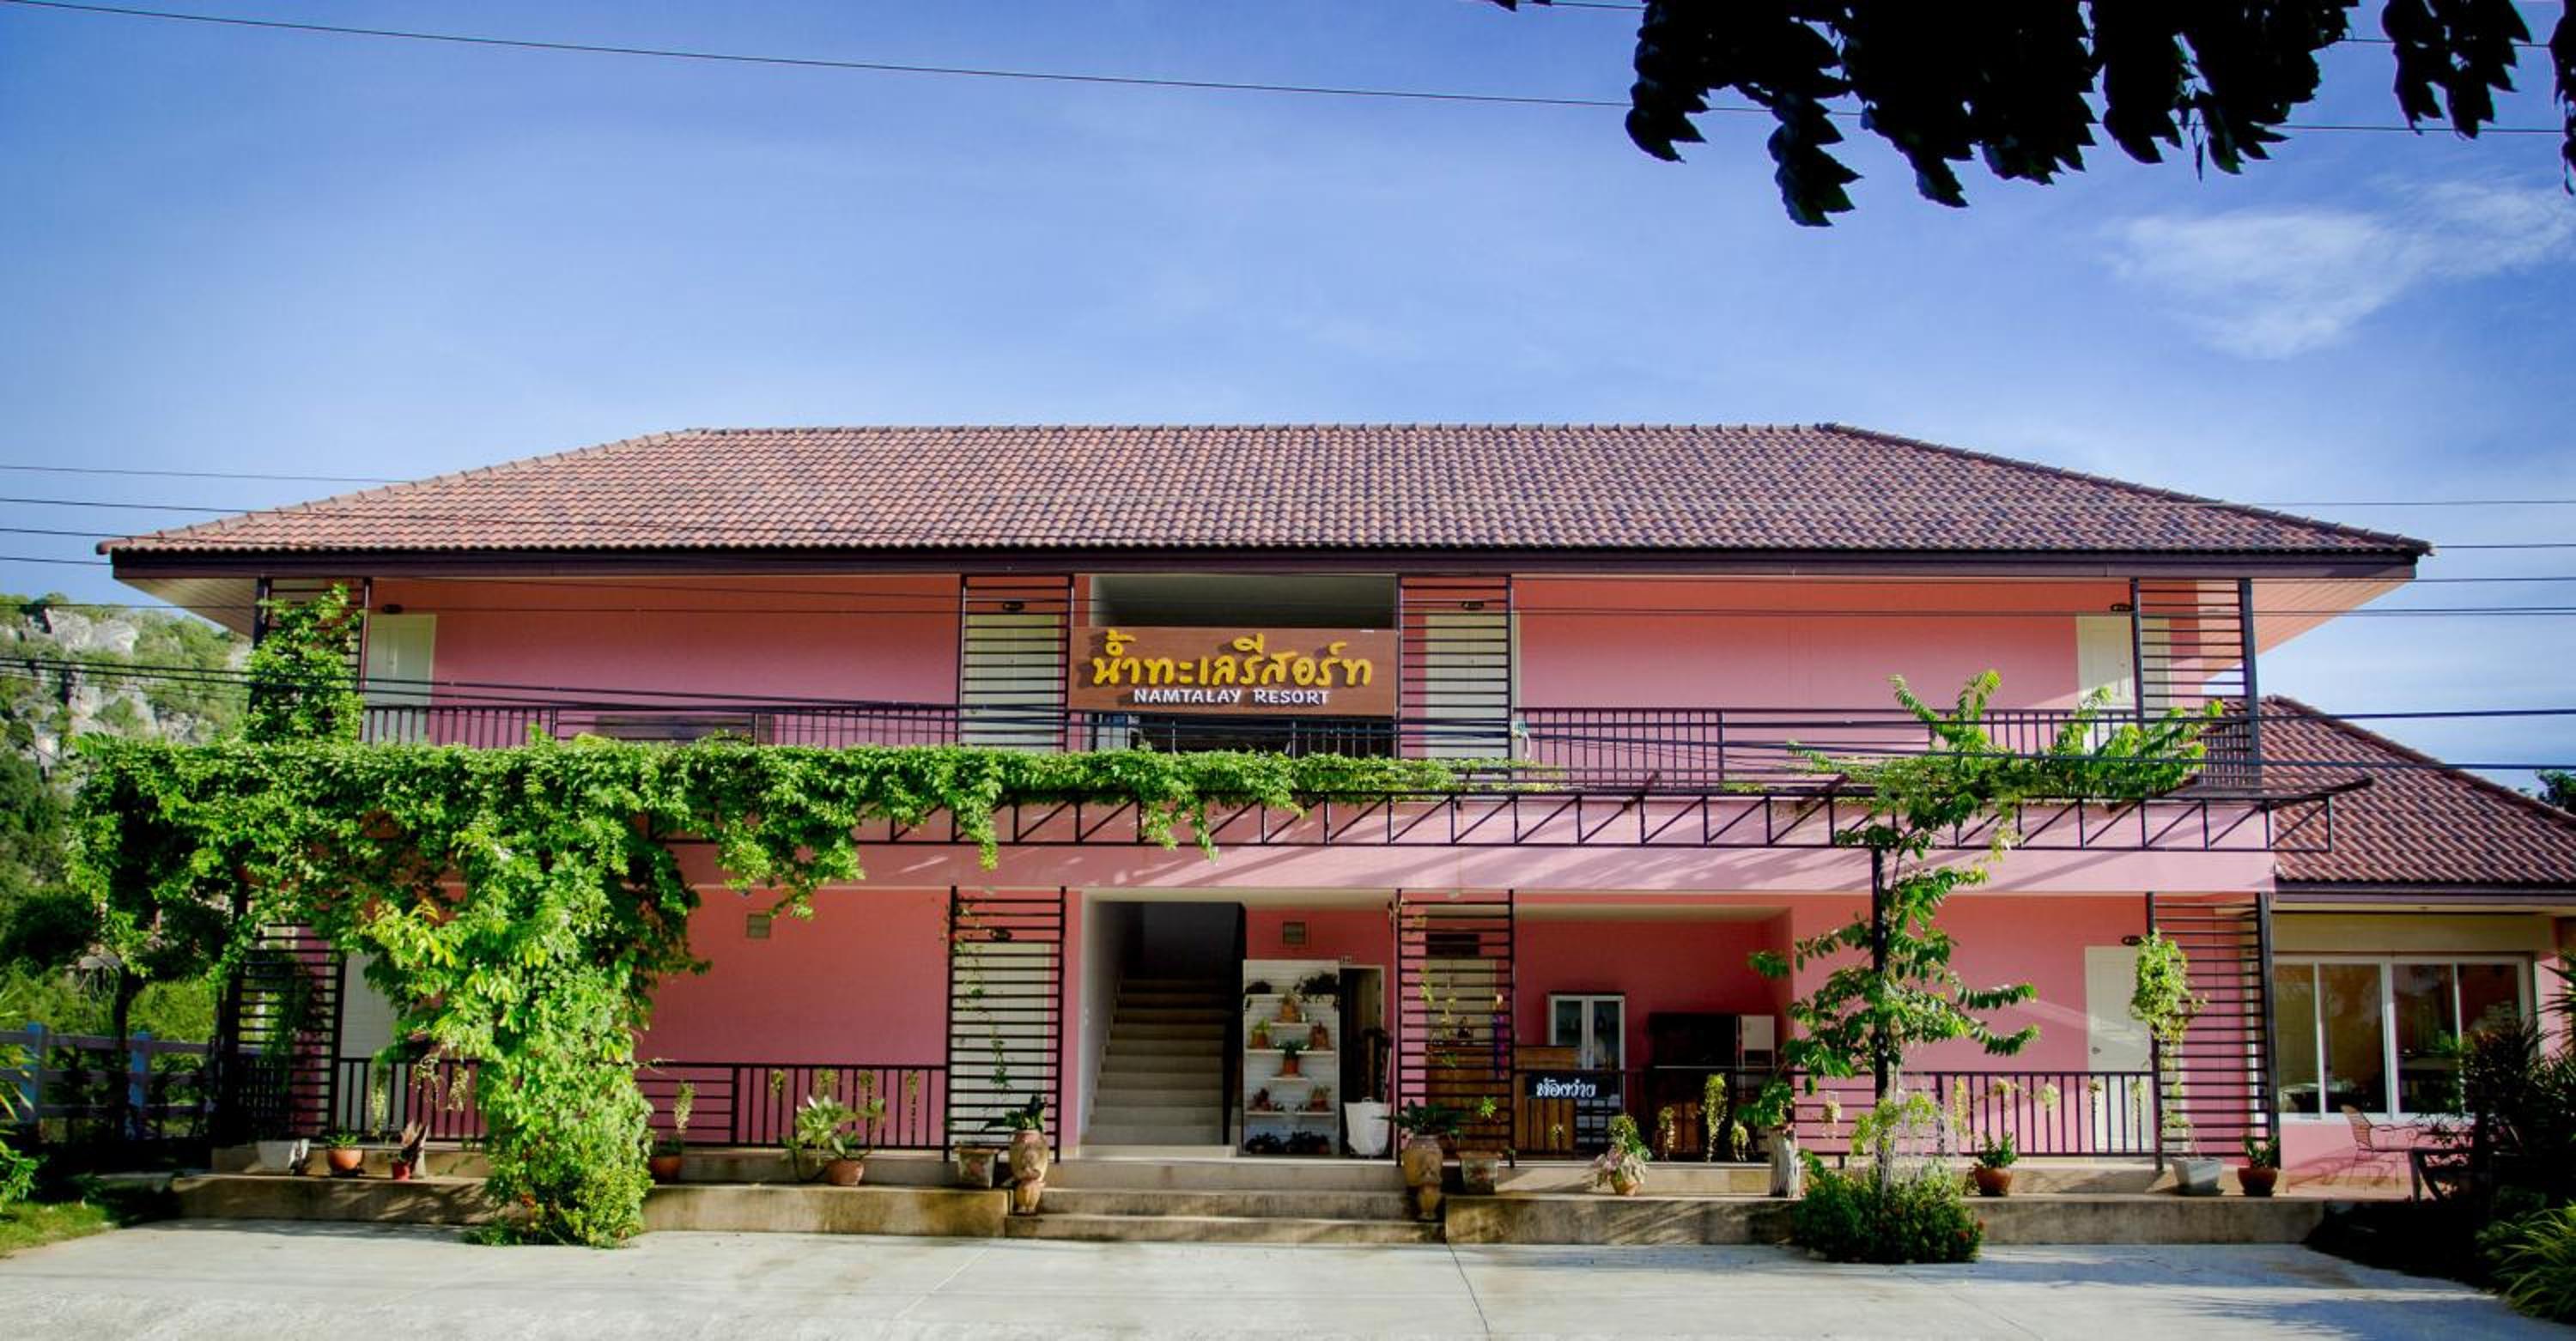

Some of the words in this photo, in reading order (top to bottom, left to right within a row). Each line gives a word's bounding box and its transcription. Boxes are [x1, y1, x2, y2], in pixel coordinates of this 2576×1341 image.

[1093, 630, 1372, 686] น้ำทะเลรีสอร์ท
[1134, 689, 1242, 704] NAMTALAY
[1254, 689, 1330, 704] RESORT
[1536, 1077, 1595, 1097] ห้องว่าง
